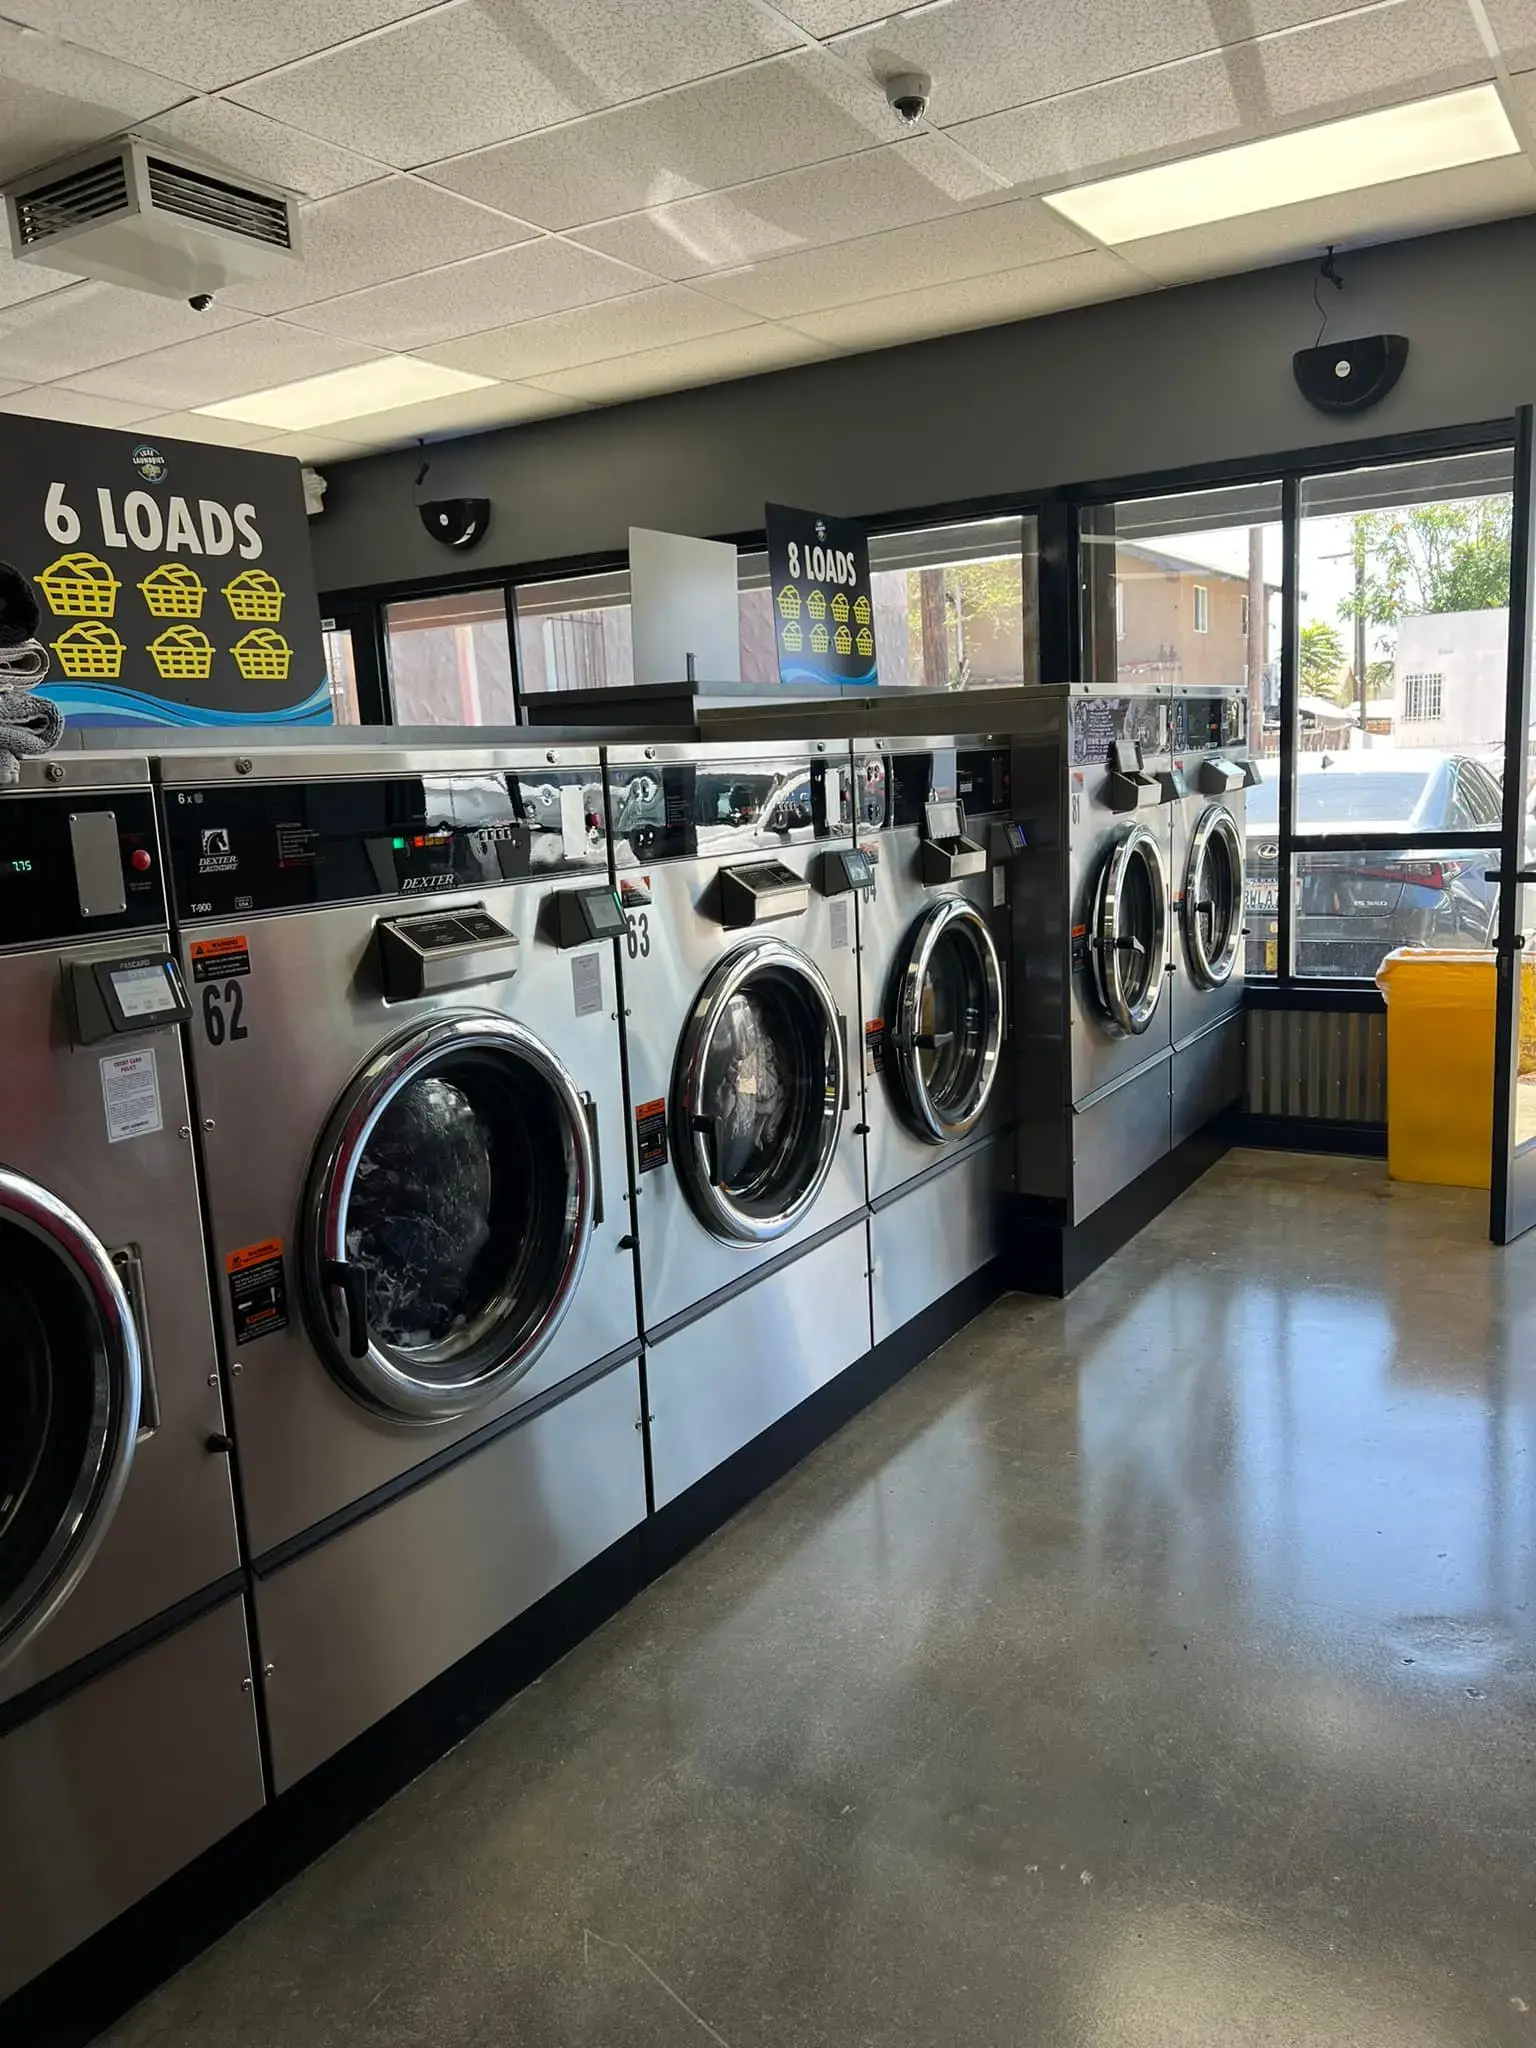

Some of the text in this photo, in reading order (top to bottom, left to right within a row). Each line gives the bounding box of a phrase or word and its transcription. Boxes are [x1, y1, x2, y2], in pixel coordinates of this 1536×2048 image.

[44, 481, 263, 560] 6 LOADS
[787, 541, 857, 587] 8 LOADS
[178, 792, 185, 805] 6
[199, 855, 239, 866] DEXTER
[199, 863, 239, 873] LAUNDRY
[402, 873, 455, 890] DEXTER
[190, 902, 213, 912] T-900
[626, 913, 650, 959] 63
[202, 979, 248, 1046] 62
